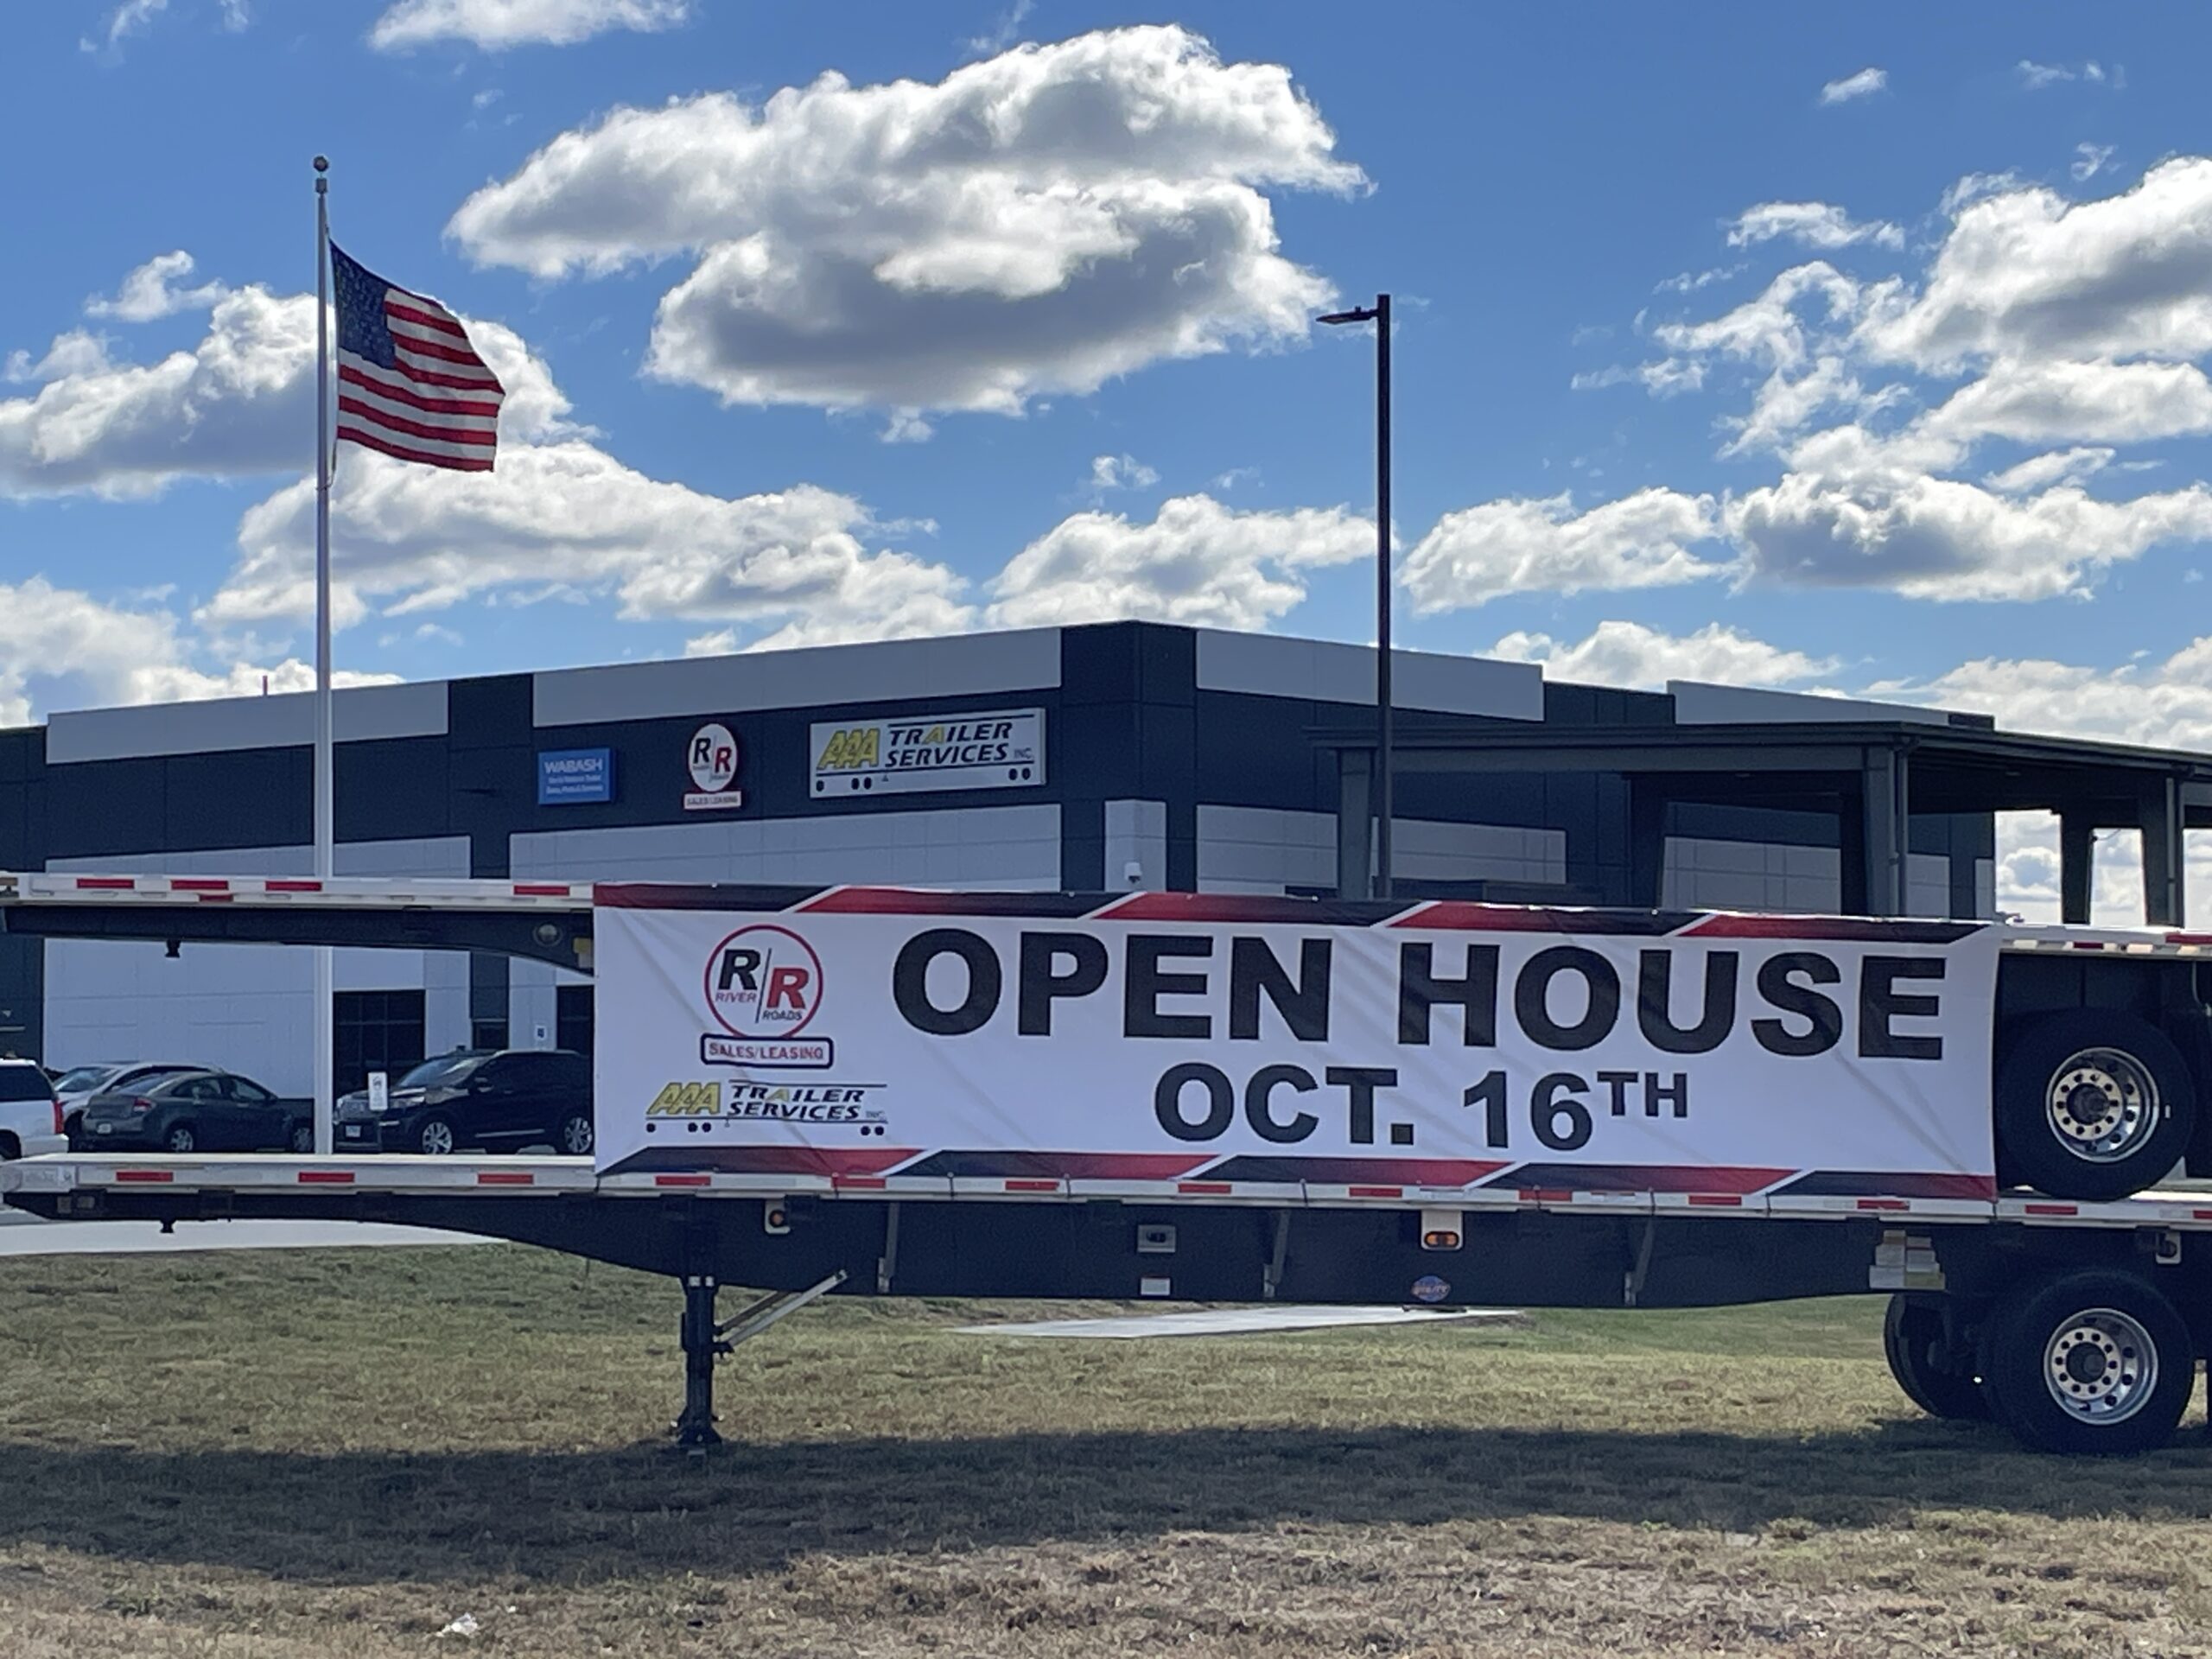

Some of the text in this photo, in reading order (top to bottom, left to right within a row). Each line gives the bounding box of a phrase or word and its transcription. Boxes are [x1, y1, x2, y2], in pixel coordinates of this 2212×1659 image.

[889, 722, 1013, 747] TRAILER
[693, 738, 711, 764] R
[715, 747, 732, 772] R
[816, 728, 880, 771] AAA
[885, 742, 1009, 767] SERVICES
[543, 758, 603, 774] WABASH
[717, 949, 761, 990] R
[715, 991, 757, 1003] RIVER
[766, 967, 810, 1009] R
[893, 928, 1948, 1060] OPEN HOUSE
[762, 1009, 803, 1021] ROADS
[645, 1082, 721, 1116] AAA
[731, 1085, 865, 1103] TRAILER
[1154, 1062, 1414, 1146] OCT.
[727, 1101, 860, 1121] SERVICES
